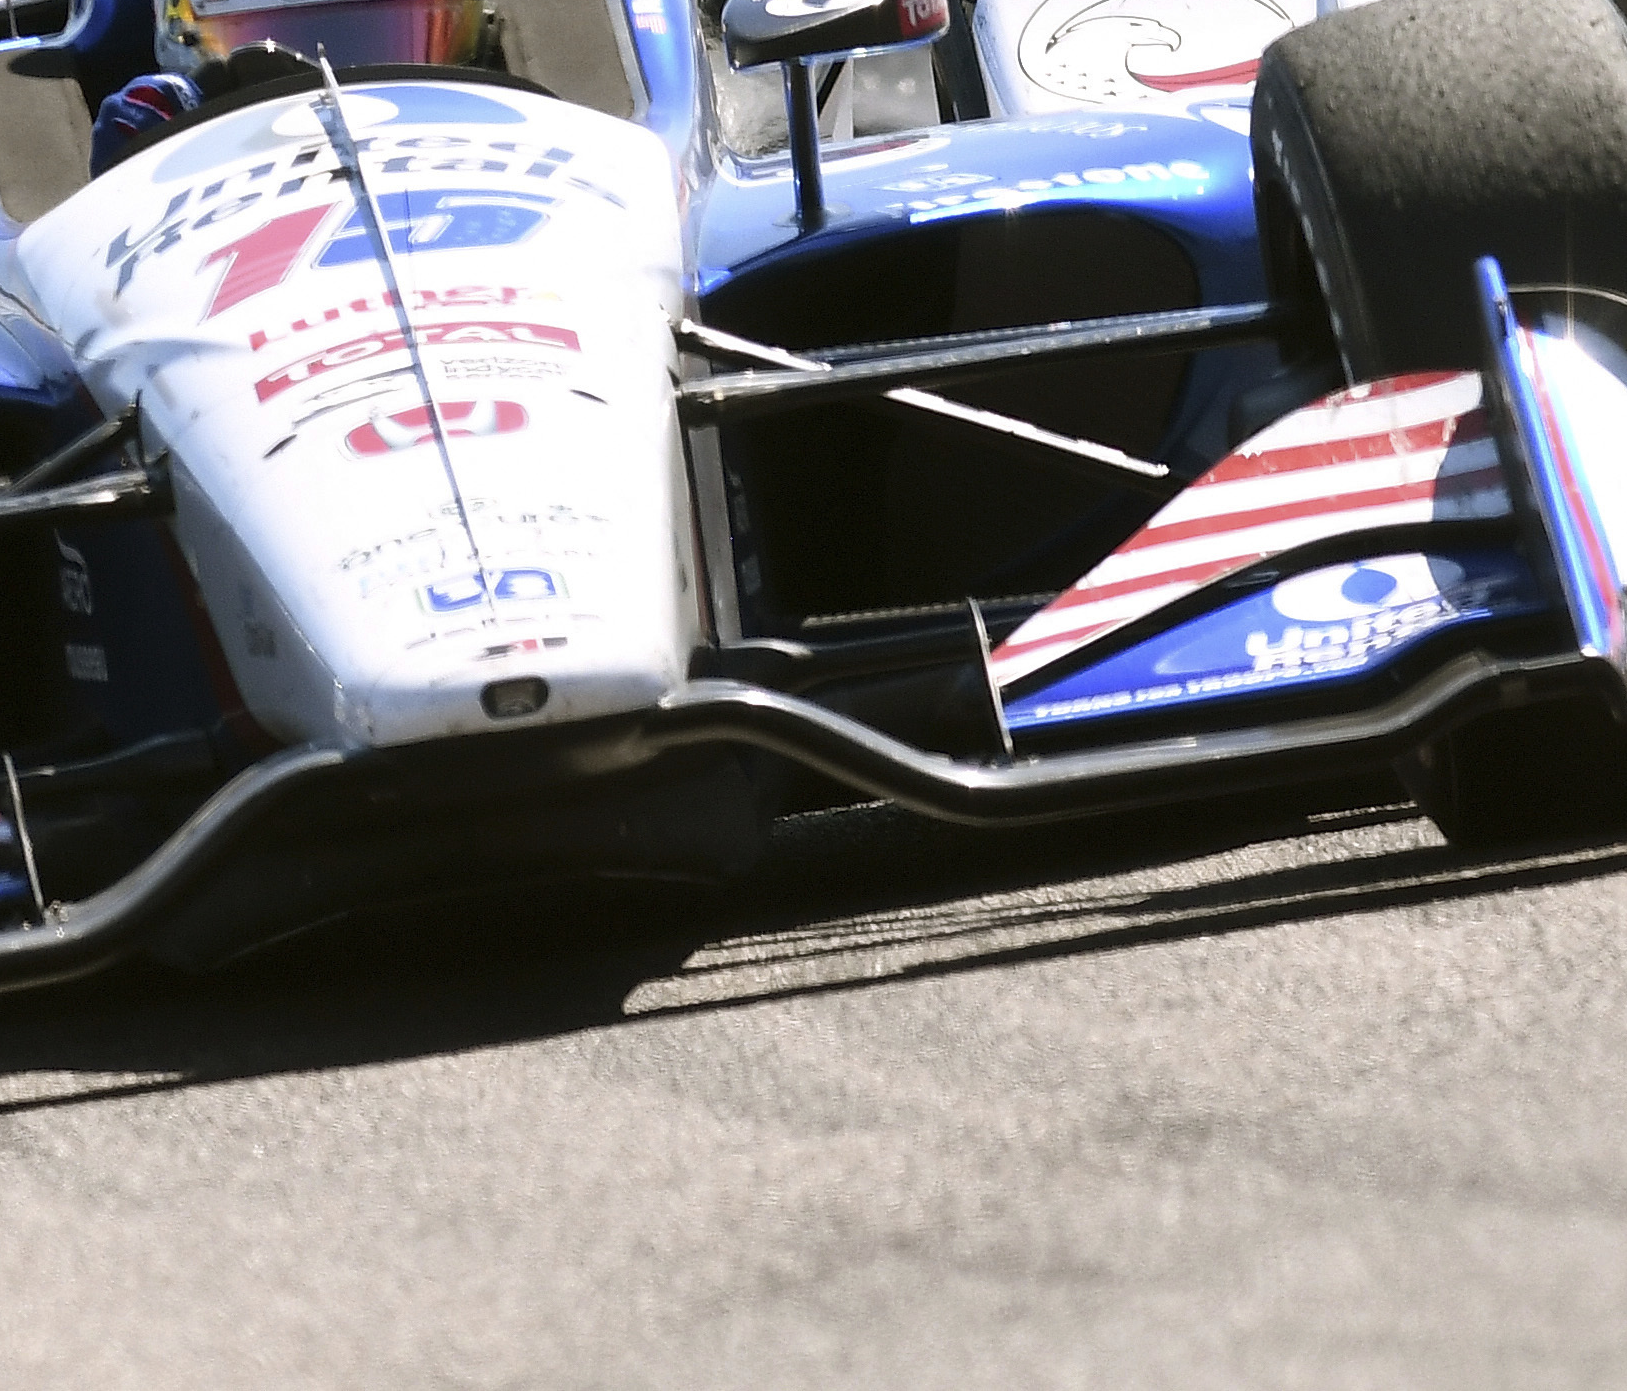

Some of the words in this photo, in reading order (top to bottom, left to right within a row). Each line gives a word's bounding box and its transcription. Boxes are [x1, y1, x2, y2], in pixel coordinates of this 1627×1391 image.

[106, 134, 575, 268] United
[115, 155, 627, 299] Rentals
[198, 187, 565, 325] 15
[246, 282, 535, 351] Luther
[266, 321, 553, 387] TOTAL
